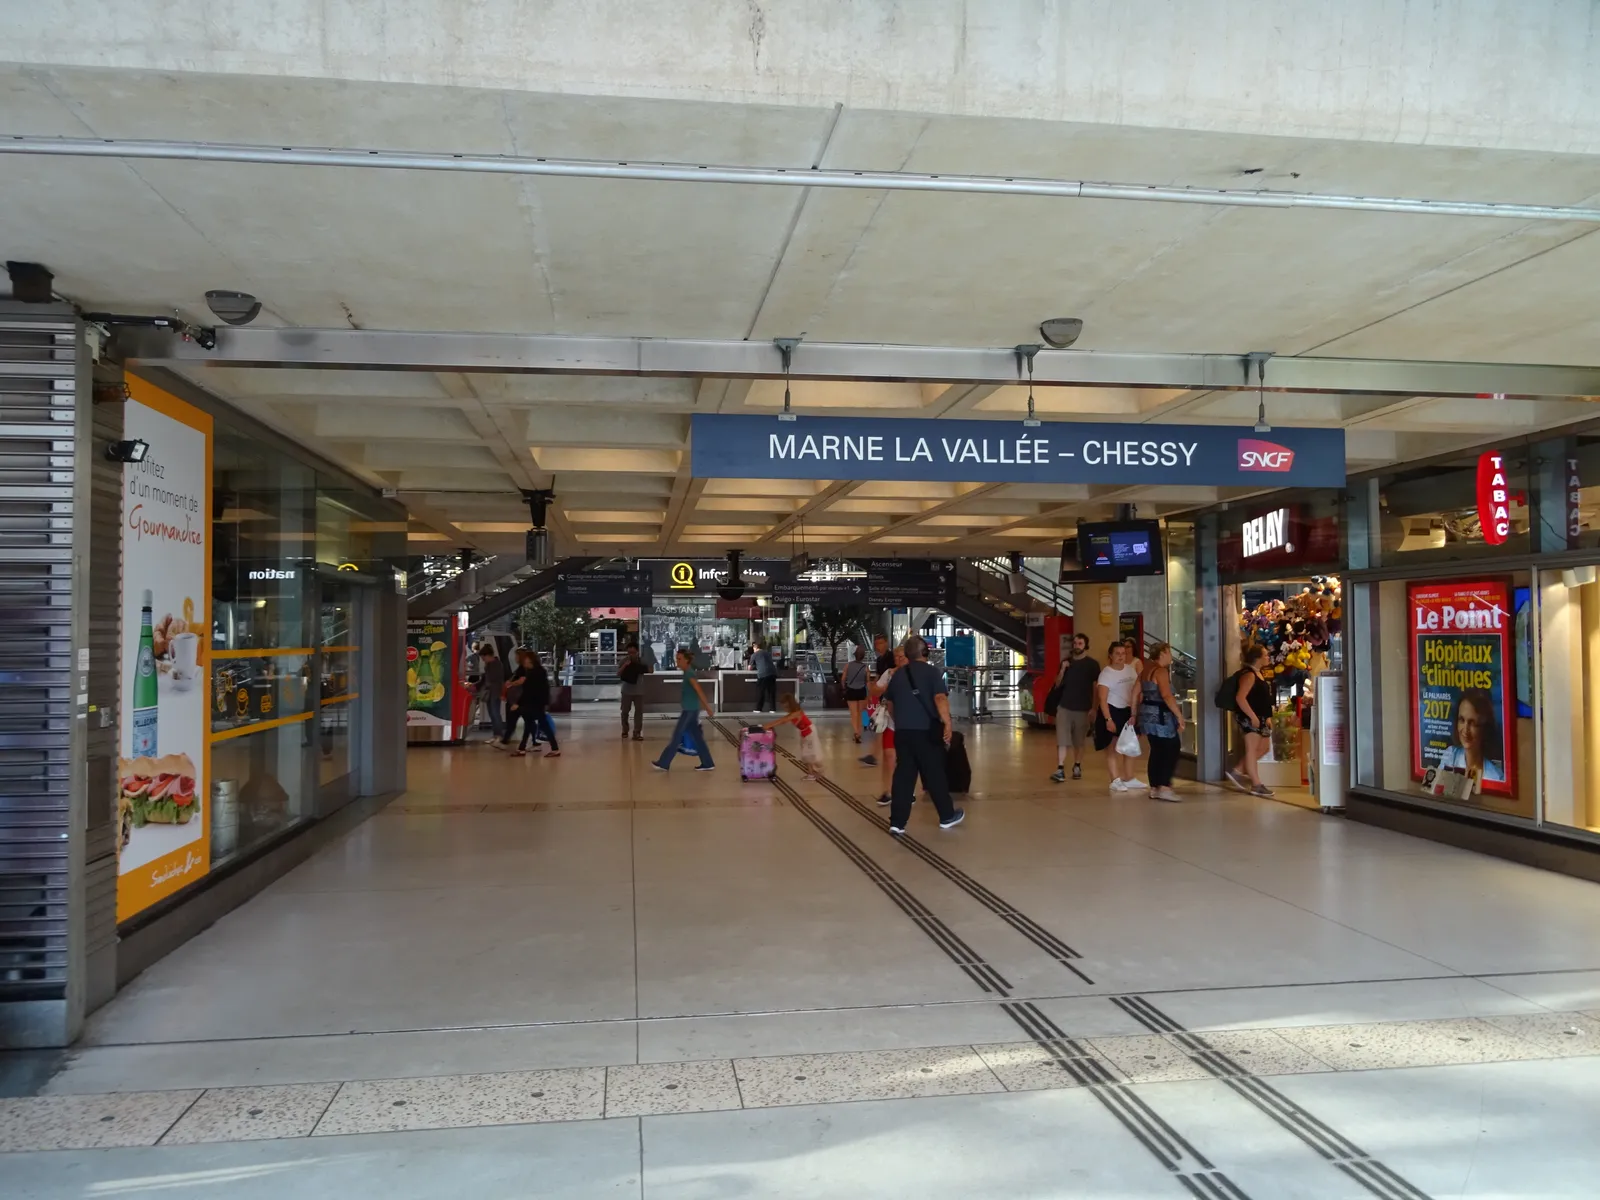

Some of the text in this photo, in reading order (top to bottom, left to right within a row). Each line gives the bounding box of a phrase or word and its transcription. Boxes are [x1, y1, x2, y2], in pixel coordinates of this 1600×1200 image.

[769, 434, 883, 461] MARNE
[895, 437, 933, 462] LA
[941, 433, 1049, 464] VALLÉE
[1083, 440, 1198, 466] CHESSY
[1240, 451, 1290, 468] SNCF
[130, 475, 198, 512] d'un moment de
[1490, 456, 1509, 536] TABAC
[129, 504, 203, 545] Gourmandise
[774, 584, 819, 593] Embarquement
[655, 605, 705, 614] ASSISTANCE
[657, 616, 702, 625] VOYAGEUR
[1416, 602, 1502, 630] Le Point
[1425, 639, 1492, 666] Hôpitaux
[1422, 663, 1429, 674] et
[1427, 663, 1492, 692] cliniques
[1429, 692, 1451, 700] PALMARÈS
[1424, 701, 1452, 719] 2017
